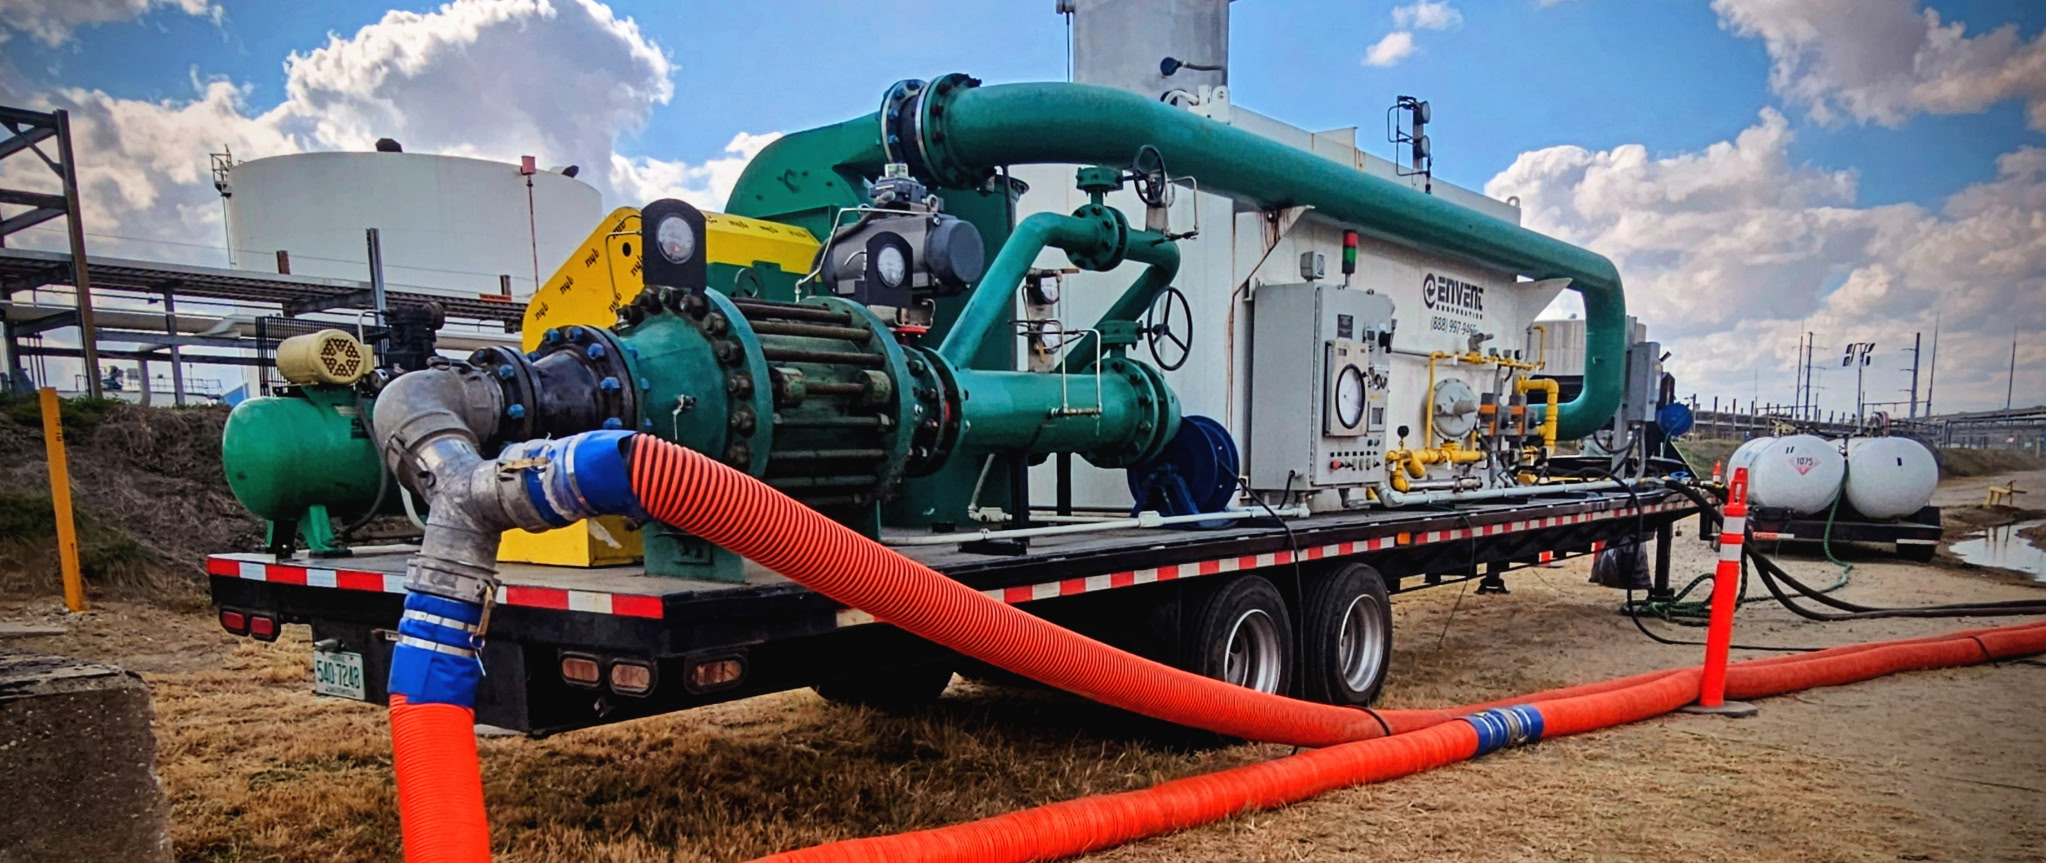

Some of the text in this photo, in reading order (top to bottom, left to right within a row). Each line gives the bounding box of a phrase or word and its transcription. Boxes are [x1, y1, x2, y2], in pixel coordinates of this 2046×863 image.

[585, 248, 600, 269] nyb
[559, 275, 574, 295] nyb
[1437, 276, 1484, 311] ENVENT
[535, 301, 549, 321] nyb
[1430, 315, 1448, 333] (888)
[1796, 457, 1814, 466] 1075
